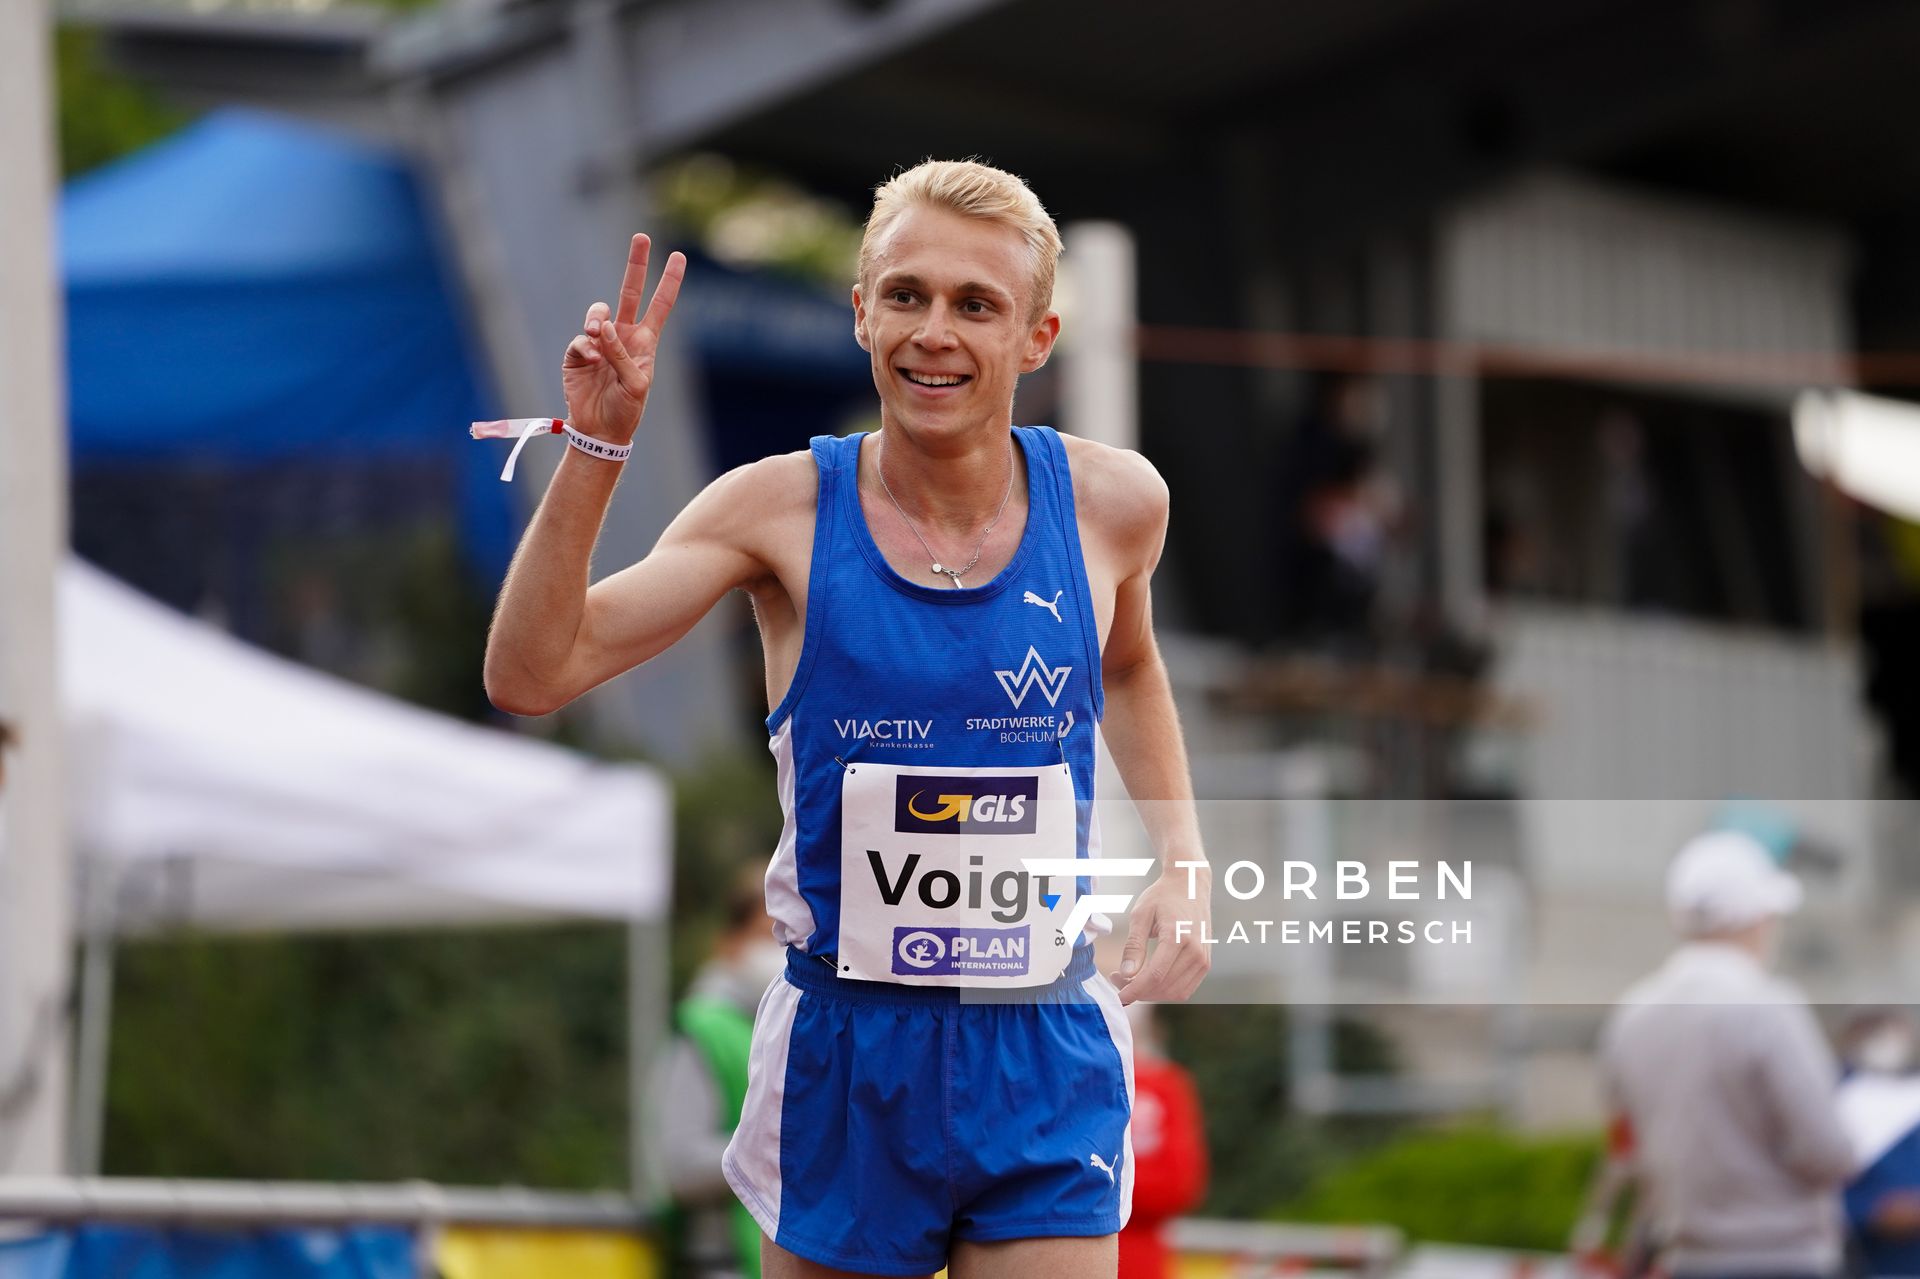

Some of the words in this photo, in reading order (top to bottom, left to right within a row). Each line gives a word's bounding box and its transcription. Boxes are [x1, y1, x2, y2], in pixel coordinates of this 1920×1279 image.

[834, 719, 933, 739] VIACTIV
[966, 716, 1055, 730] STADTWERKE
[1000, 731, 1055, 743] BOCHUM
[869, 741, 934, 749] Krankenkasse
[972, 794, 1026, 822] GLS
[951, 937, 1024, 958] PLAN
[951, 961, 1024, 970] INTERNATIONAL
